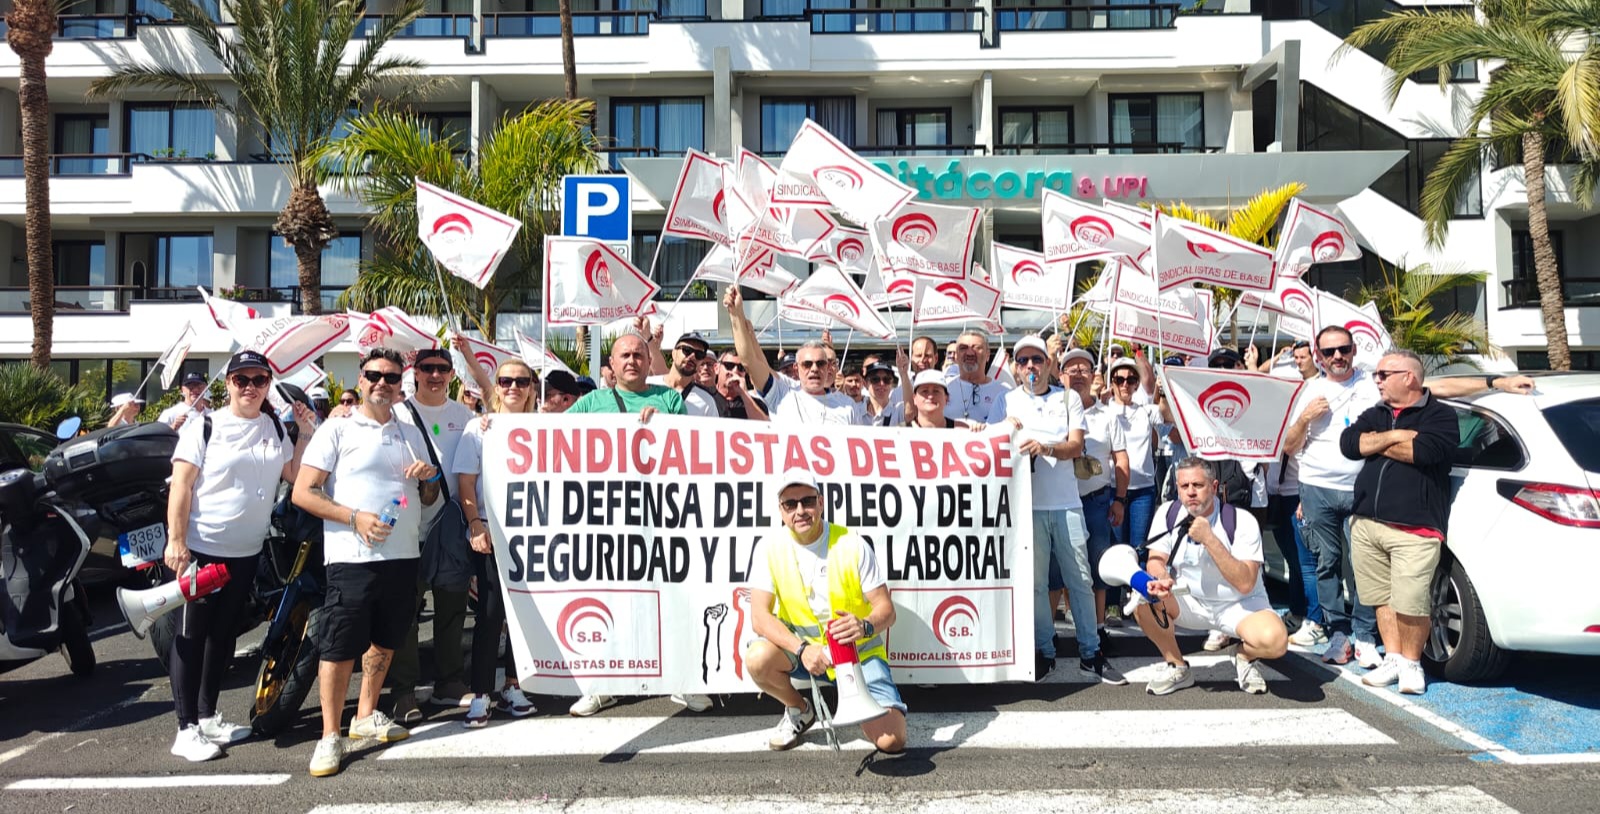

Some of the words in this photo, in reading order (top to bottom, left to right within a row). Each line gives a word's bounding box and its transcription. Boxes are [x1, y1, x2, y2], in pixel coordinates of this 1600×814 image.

[1077, 176, 1096, 198] &
[1103, 177, 1148, 198] UP!
[576, 183, 620, 235] P
[1223, 270, 1238, 280] DE
[1239, 272, 1267, 284] BASE
[1118, 322, 1171, 341] SINDICALISAS
[1172, 334, 1184, 344] DE
[1184, 336, 1207, 349] BASE
[1211, 406, 1237, 419] S.B.
[506, 427, 835, 476] SINDICALISTAS
[846, 437, 901, 479] DE
[910, 433, 1013, 480] BASE
[1246, 439, 1273, 450] BASE
[505, 480, 550, 528] EN
[562, 480, 703, 528] DEFENSA
[713, 481, 771, 528] DEL
[909, 485, 926, 528] Y
[936, 484, 973, 528] DE
[981, 483, 1012, 528] LA
[129, 526, 162, 546] 3363
[132, 542, 157, 560] JNK
[508, 532, 690, 583] SEGURIDAD
[700, 536, 719, 583] Y
[886, 534, 1010, 582] LABORAL
[576, 631, 607, 643] S.B.
[949, 626, 974, 638] S.B.
[609, 659, 624, 669] DE
[628, 659, 659, 669] BASE
[889, 651, 972, 661] SINDICALISTAS
[975, 651, 988, 660] DE
[991, 650, 1012, 659] BASE
